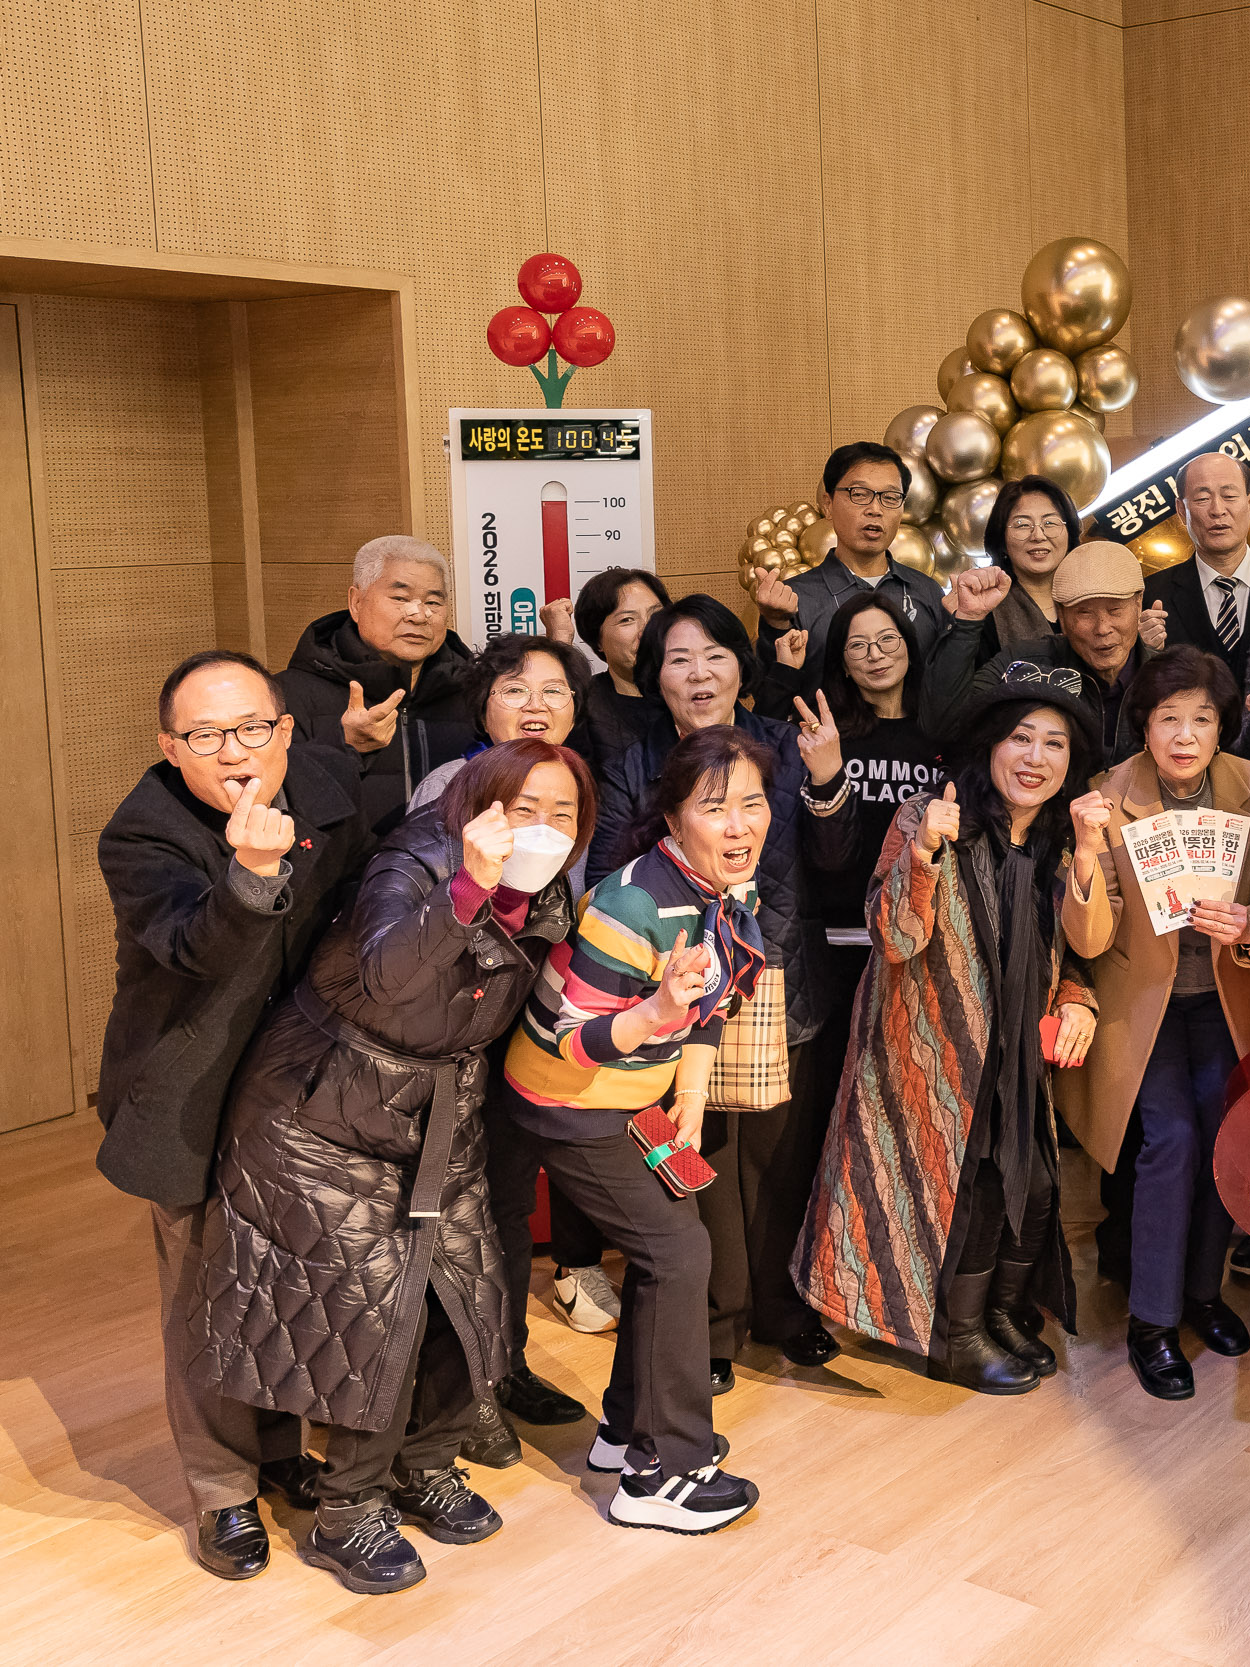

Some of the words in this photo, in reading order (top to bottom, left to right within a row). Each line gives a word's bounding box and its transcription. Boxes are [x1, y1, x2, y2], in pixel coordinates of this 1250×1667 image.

[469, 426, 511, 452] 사랑의
[516, 426, 545, 452] 온도
[602, 496, 626, 509] 100
[1105, 484, 1171, 537] 광진
[604, 529, 621, 541] 90
[1133, 838, 1149, 849] 2026
[1134, 837, 1177, 860] 따뜻한
[1139, 849, 1181, 870] 겨울나기
[1186, 849, 1215, 859] 울나기
